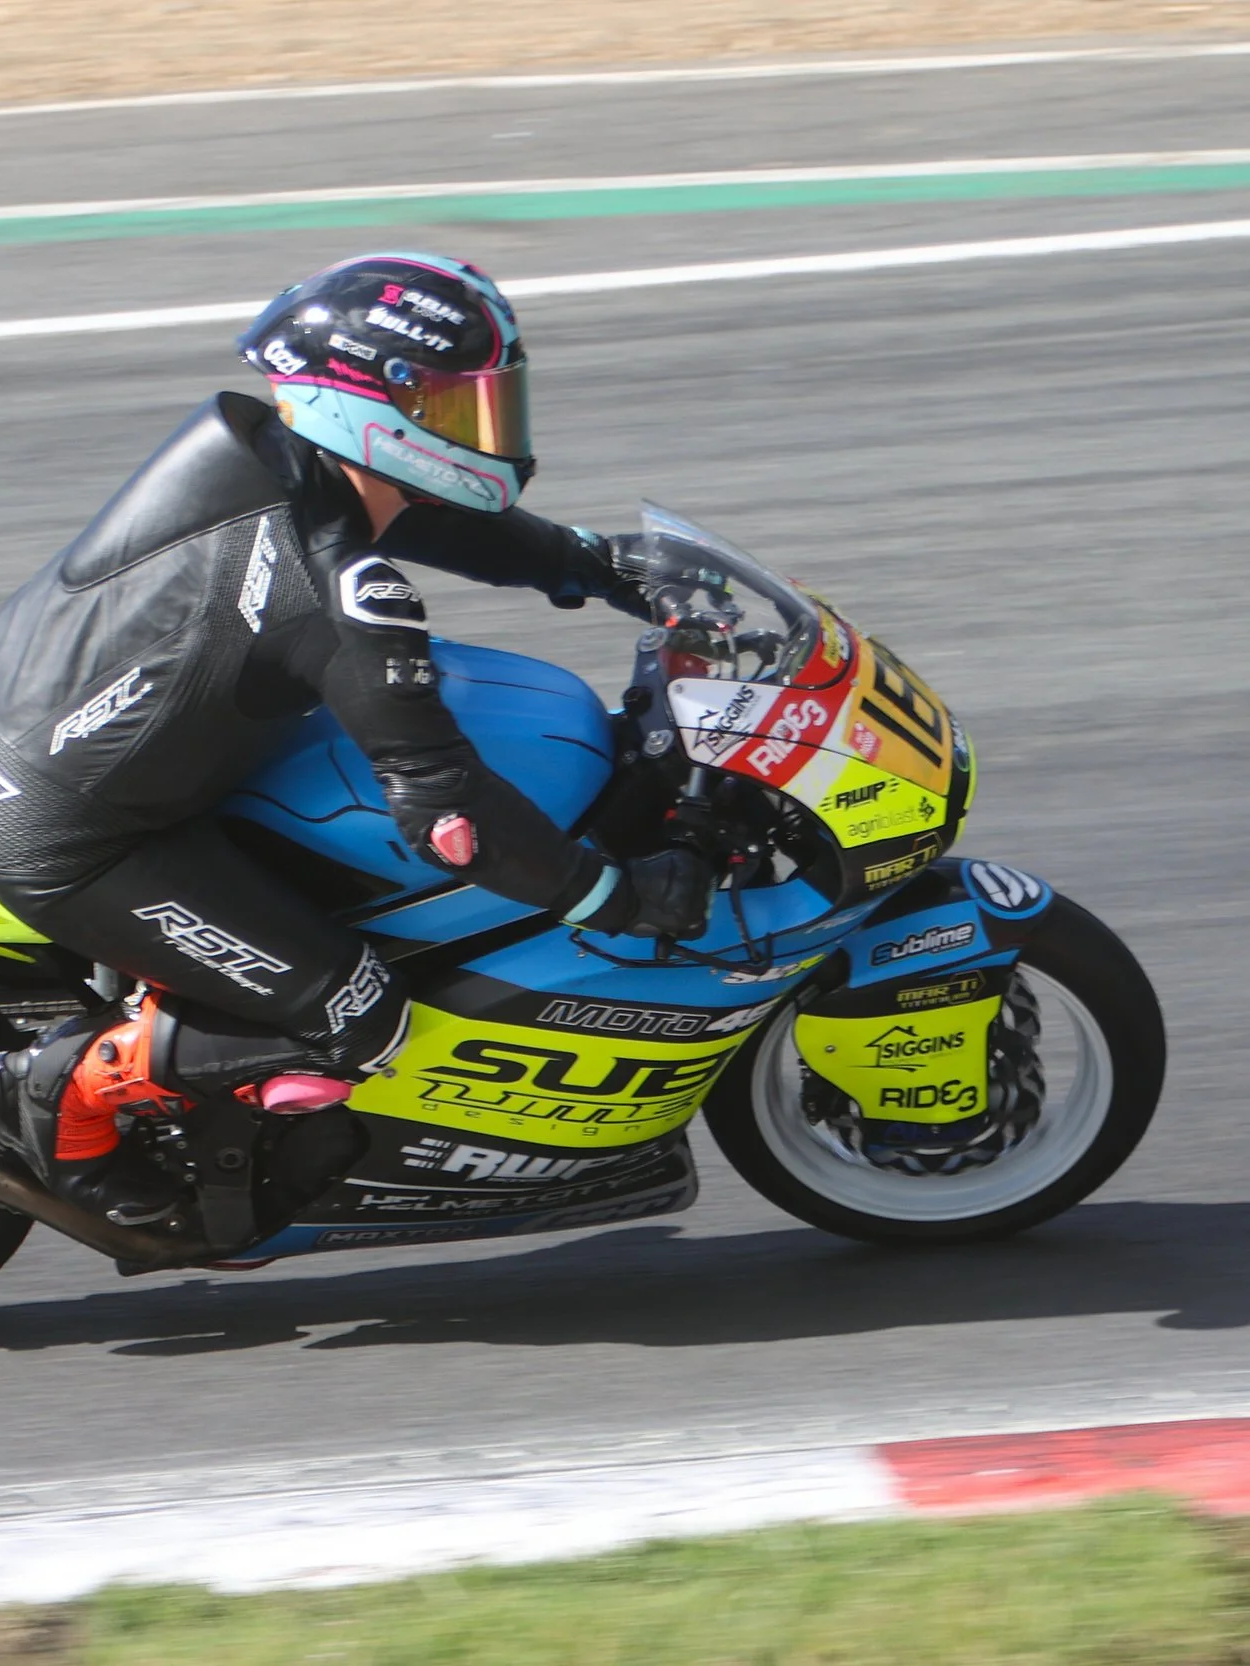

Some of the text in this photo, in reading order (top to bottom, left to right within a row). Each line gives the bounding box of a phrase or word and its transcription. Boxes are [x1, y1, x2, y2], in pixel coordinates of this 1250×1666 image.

[130, 900, 294, 974] RST
[535, 1000, 713, 1037] MOTO
[881, 1031, 966, 1060] SIGGINS
[879, 1078, 979, 1113] RIDE3
